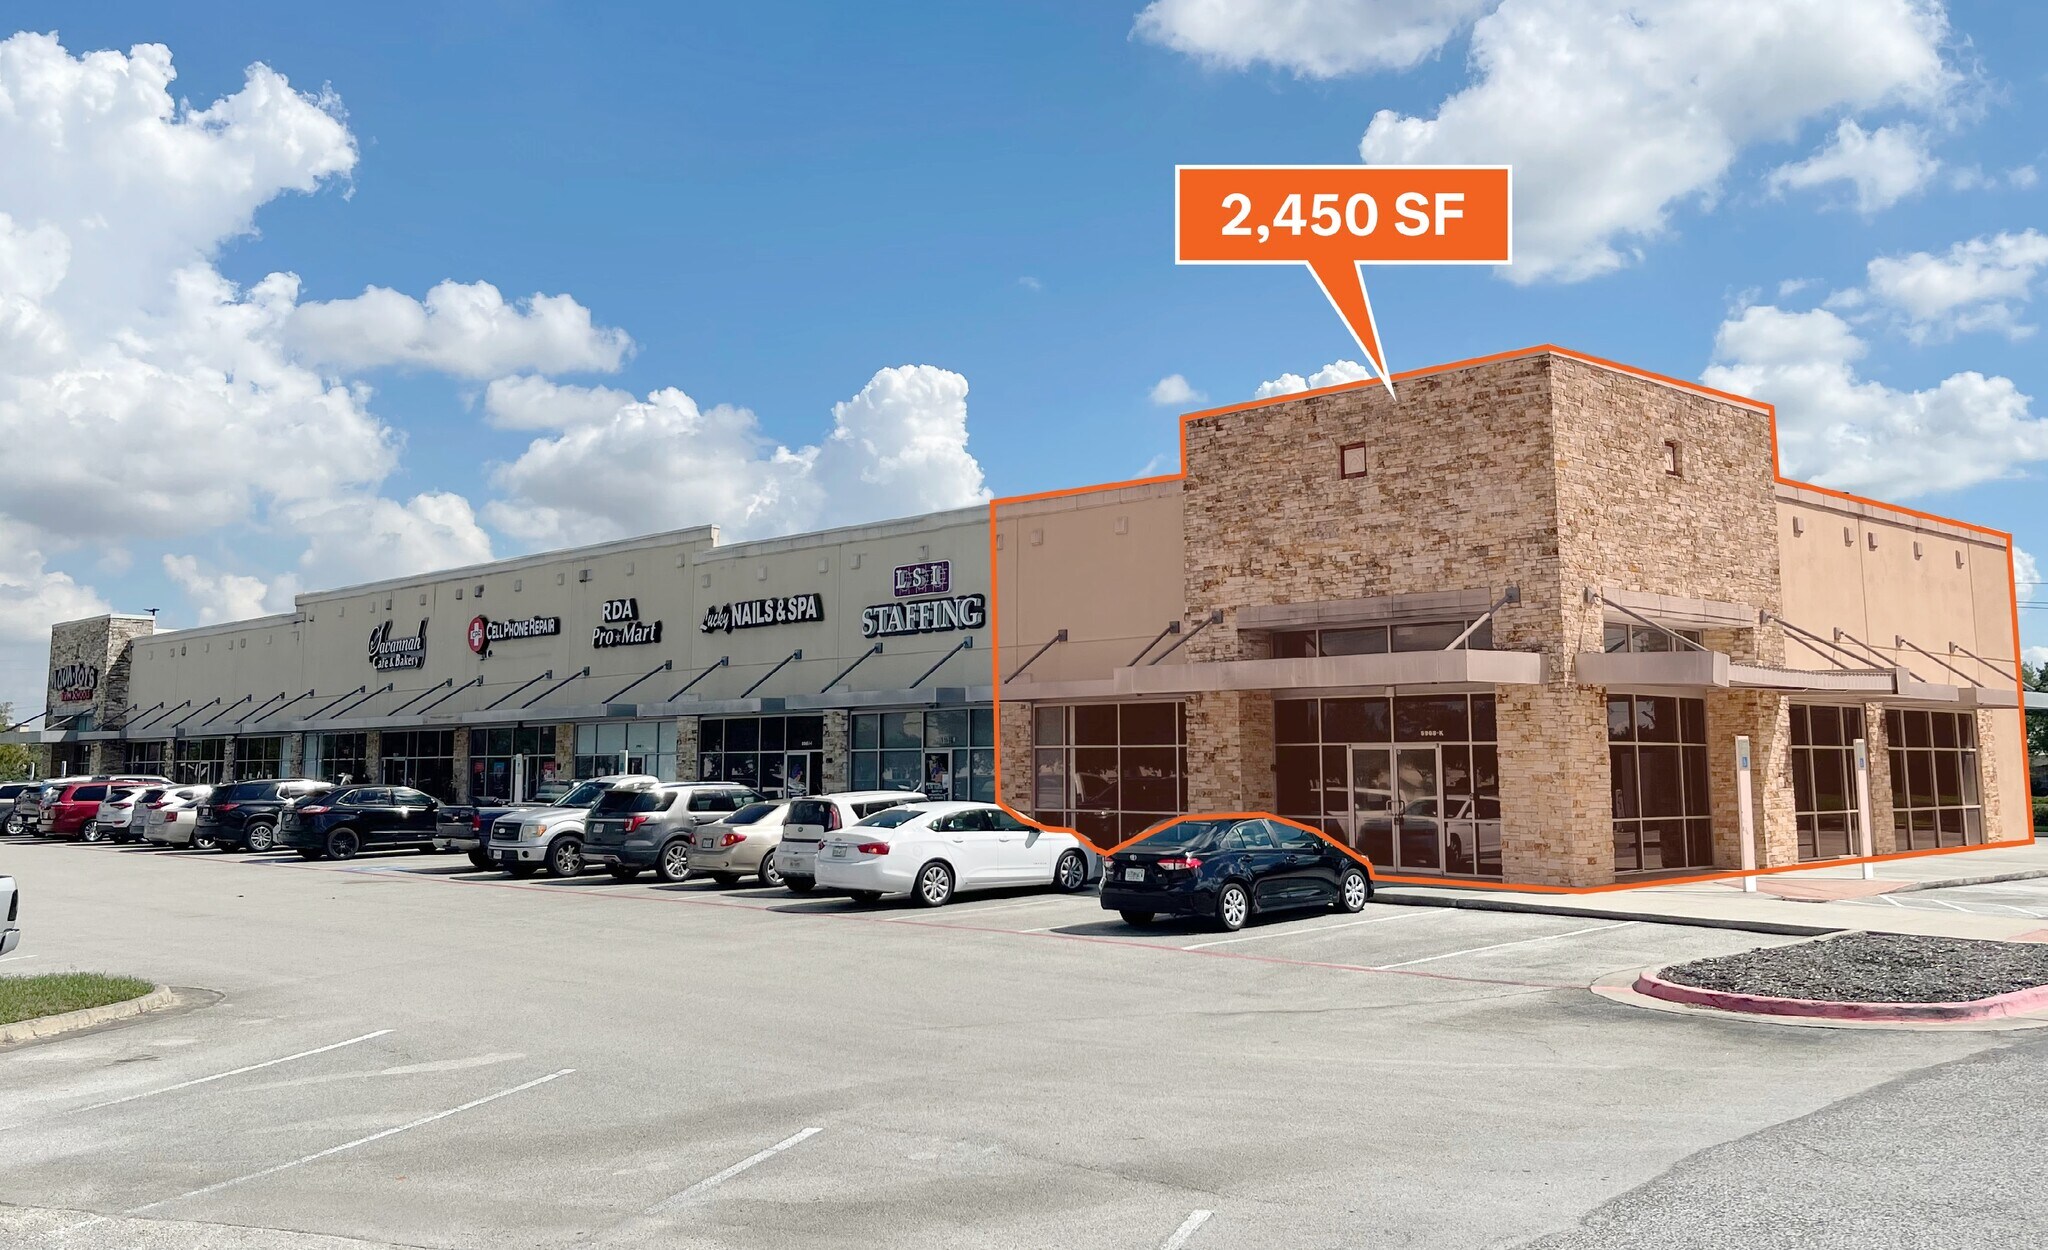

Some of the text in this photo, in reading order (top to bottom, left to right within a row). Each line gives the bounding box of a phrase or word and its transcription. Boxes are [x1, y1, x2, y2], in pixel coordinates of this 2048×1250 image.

[602, 599, 633, 621] RDA
[731, 600, 774, 627] NAILS
[776, 601, 786, 621] &
[787, 596, 818, 620] SPA
[862, 597, 982, 635] STAFFING
[368, 620, 422, 656] Savannah
[486, 617, 555, 640] CELL PHONE REPAIR
[389, 657, 395, 668] &
[395, 653, 419, 668] Bakery
